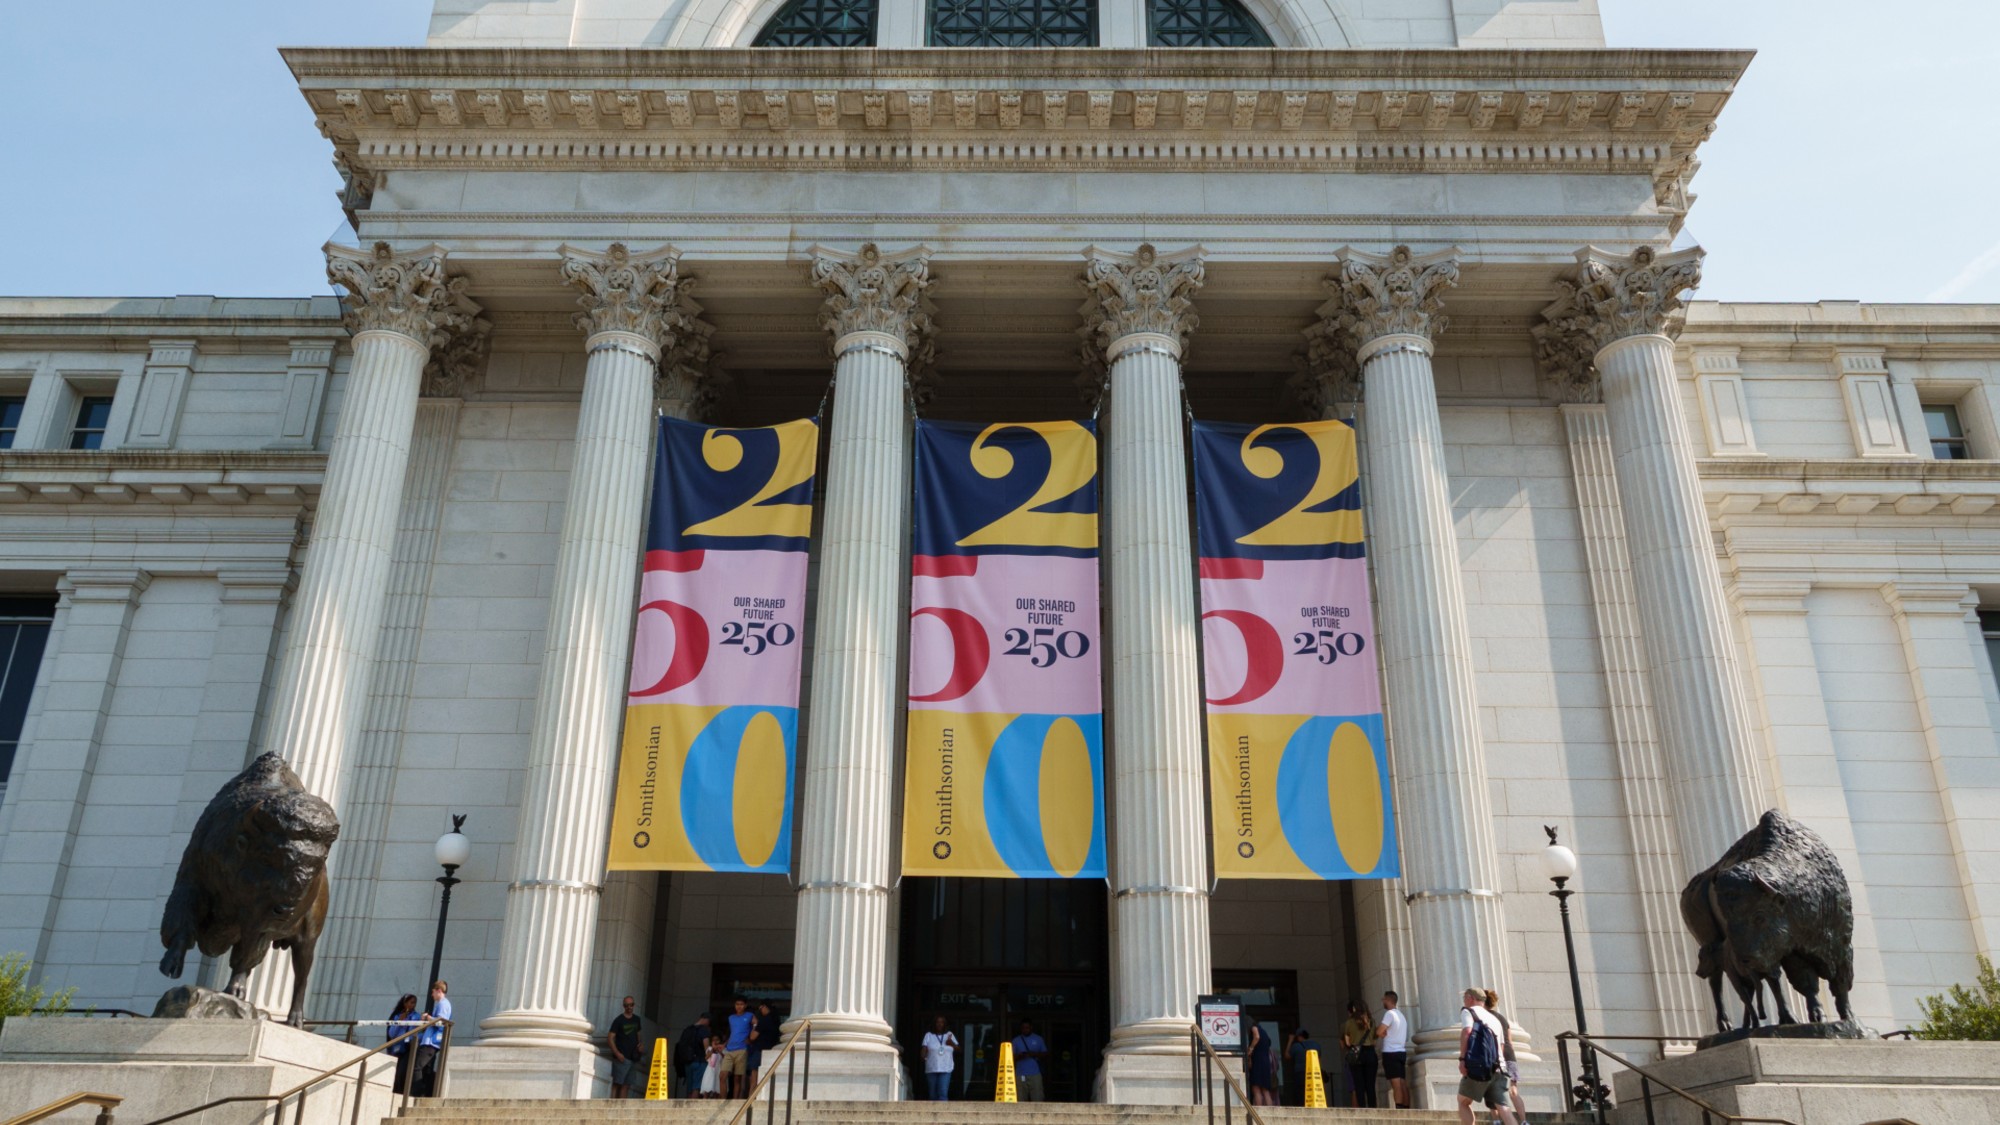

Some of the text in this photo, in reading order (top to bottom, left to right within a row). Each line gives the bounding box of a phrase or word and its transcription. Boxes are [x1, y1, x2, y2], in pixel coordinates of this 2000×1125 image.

[733, 596, 786, 609] OUR SHARED
[1016, 598, 1076, 613] OUR SHARED
[743, 608, 774, 620] FUTURE
[1301, 605, 1350, 618] OUR SHARED
[1028, 612, 1064, 626] FUTURE
[1312, 617, 1341, 629] FUTURE
[719, 621, 796, 656] 250
[1002, 627, 1090, 668] 250
[1293, 630, 1365, 665] 250
[637, 725, 661, 827] Smithsonian
[935, 728, 954, 836] Smithsonian
[1236, 735, 1253, 837] Smithsonian
[941, 993, 966, 1004] EXIT
[1027, 994, 1053, 1005] EXIT
